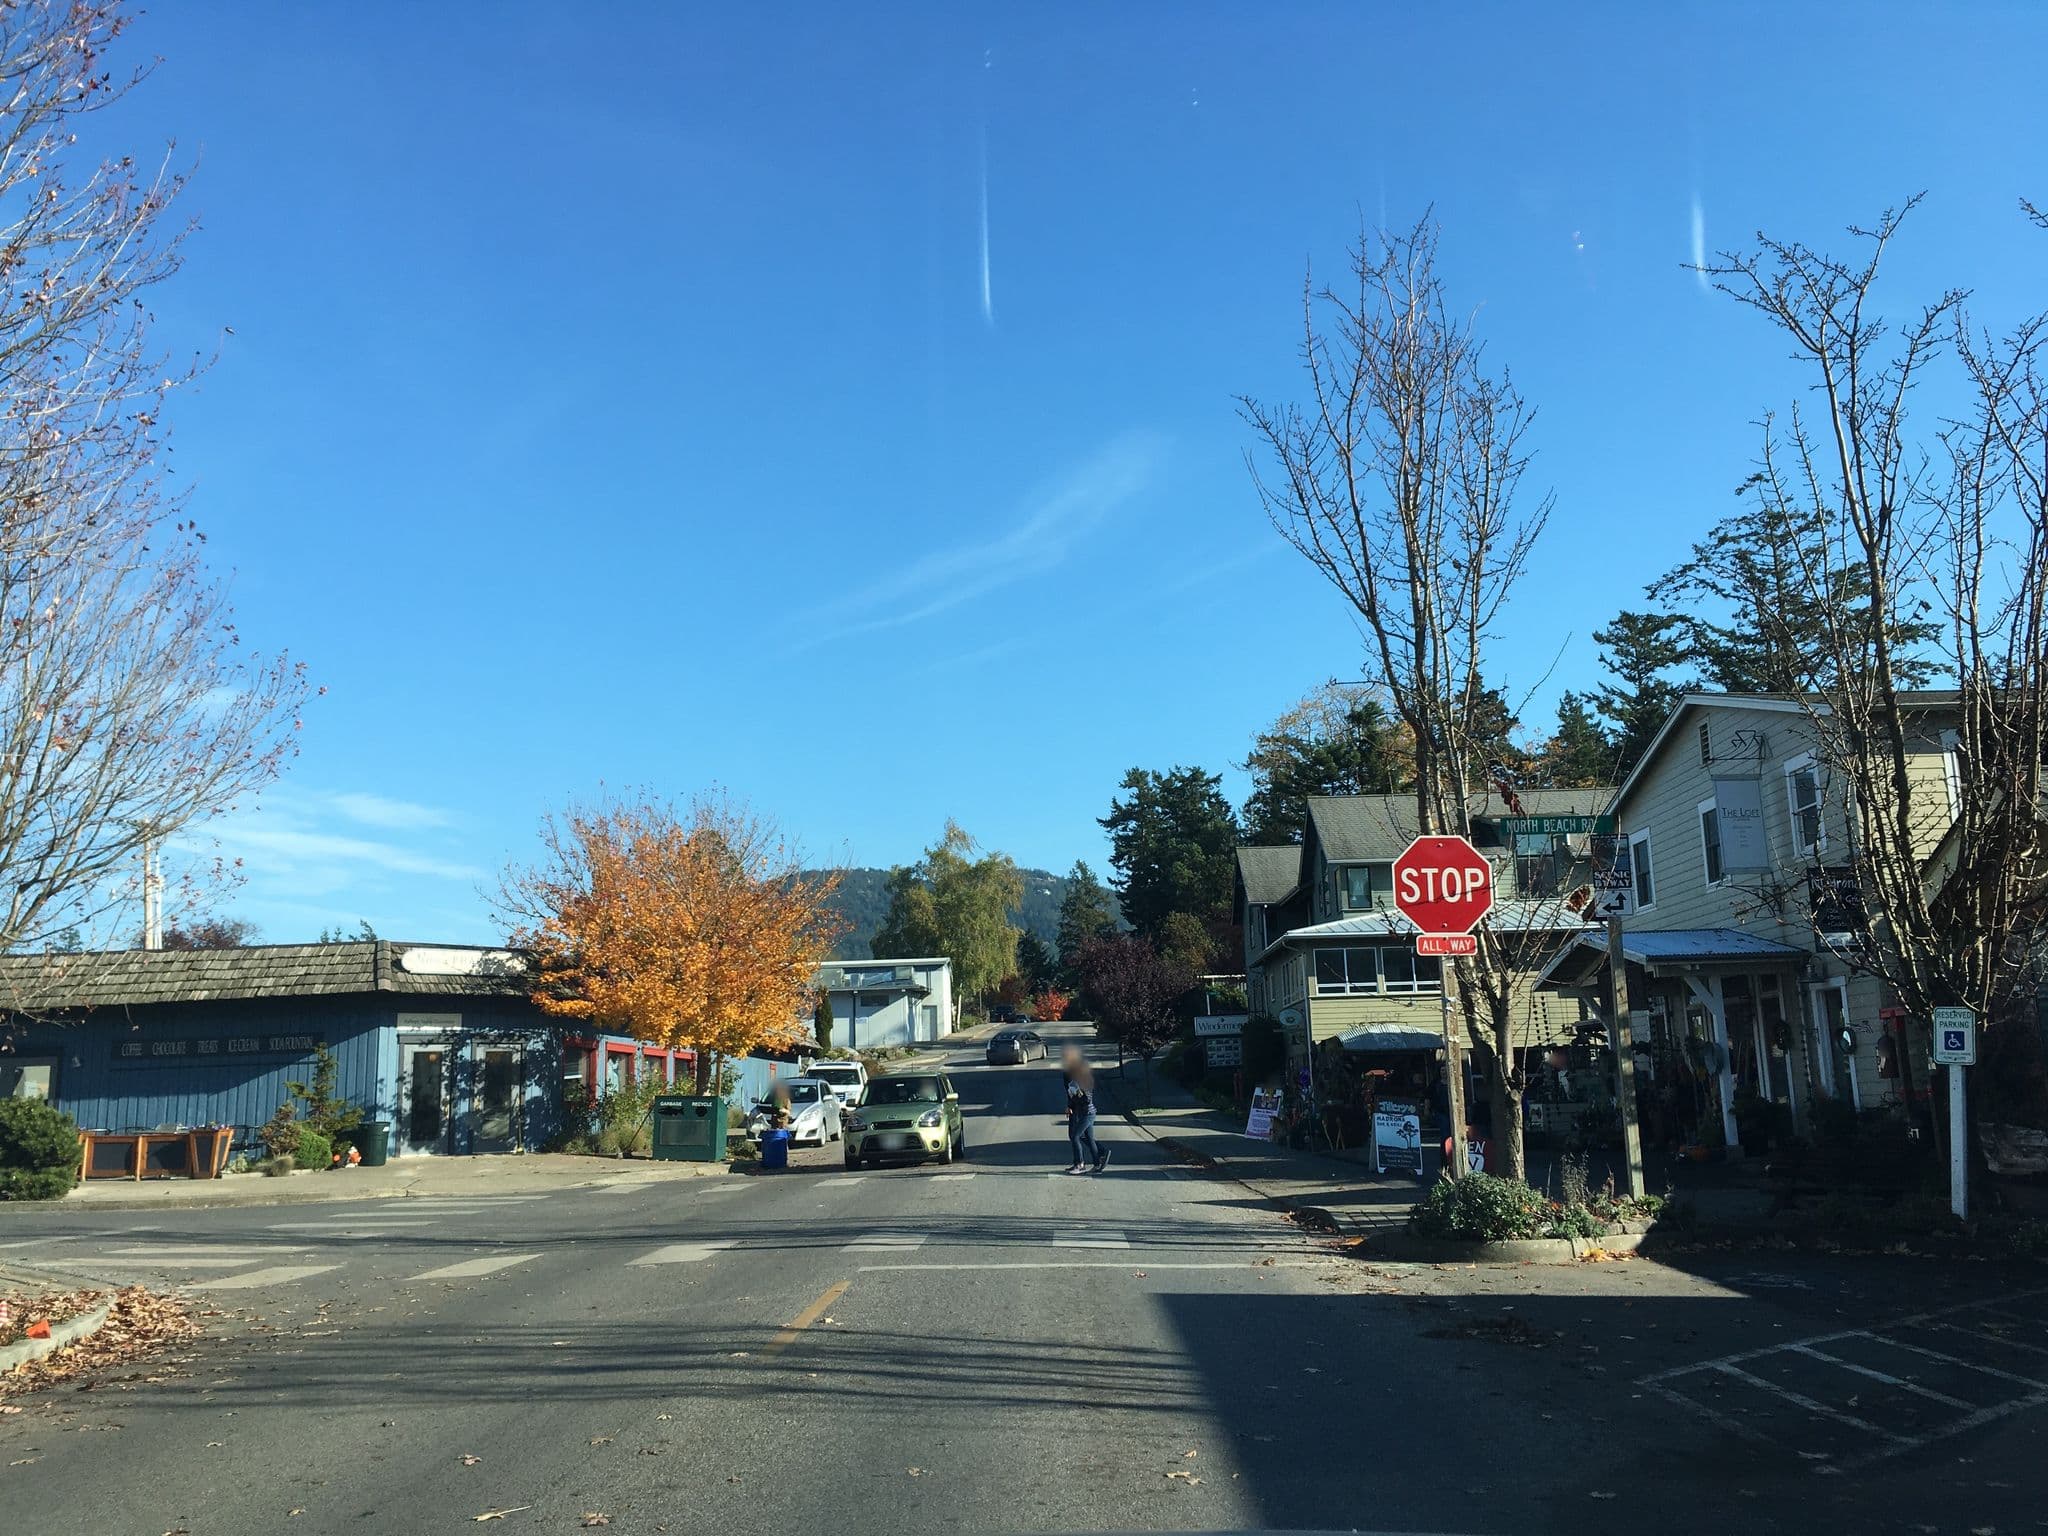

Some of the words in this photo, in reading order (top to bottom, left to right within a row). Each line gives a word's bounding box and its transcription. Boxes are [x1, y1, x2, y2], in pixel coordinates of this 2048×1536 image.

[1506, 819, 1538, 833] NORTH
[1543, 818, 1577, 832] BEACH
[1594, 871, 1630, 880] SCENIC
[1401, 867, 1485, 903] STOP
[1422, 938, 1443, 952] ALL
[1450, 938, 1472, 951] WAY
[1936, 1011, 1971, 1019] RESERVED
[121, 1043, 142, 1056] COFFEE
[152, 1041, 187, 1055] CHOCOLATE
